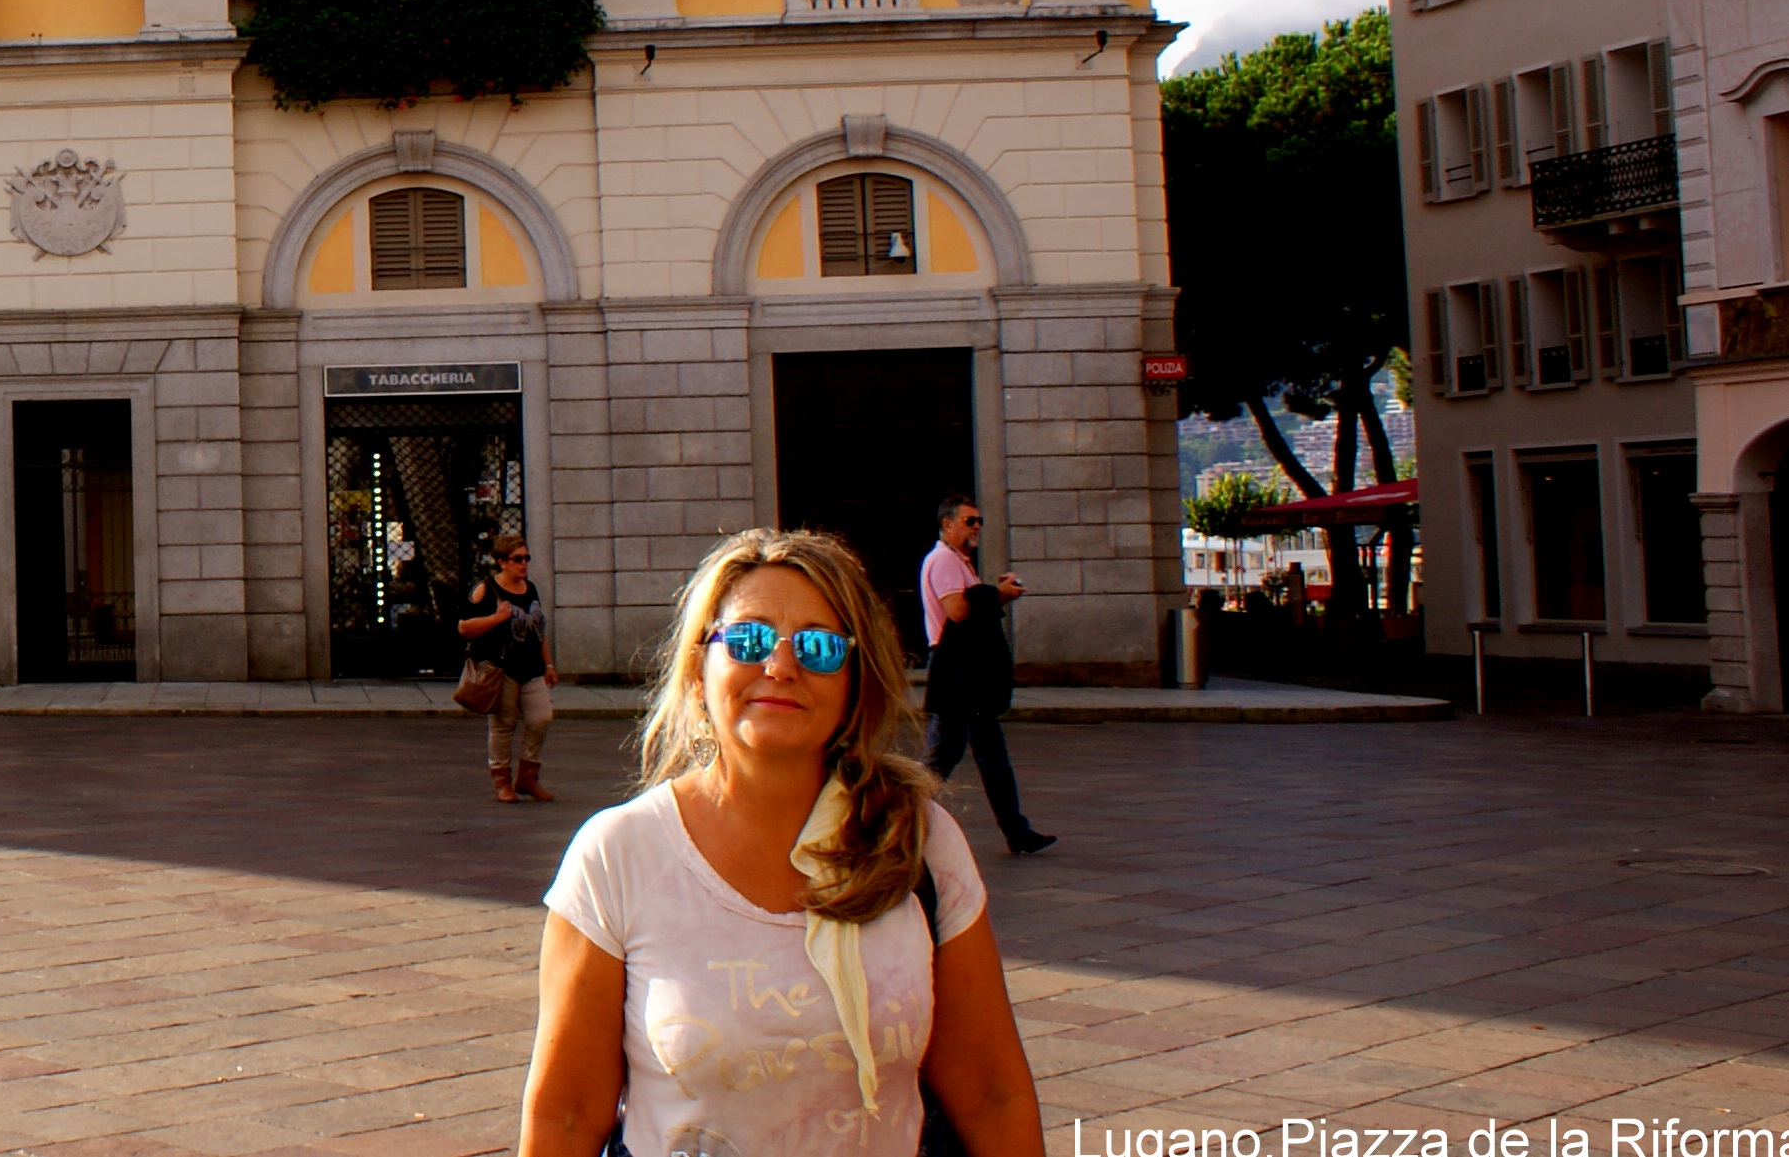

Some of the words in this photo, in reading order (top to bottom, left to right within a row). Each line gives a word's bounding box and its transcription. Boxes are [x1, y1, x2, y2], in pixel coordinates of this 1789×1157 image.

[1145, 362, 1183, 374] POLIZIA
[369, 372, 476, 386] TABACCHERIA
[707, 960, 821, 1018] The
